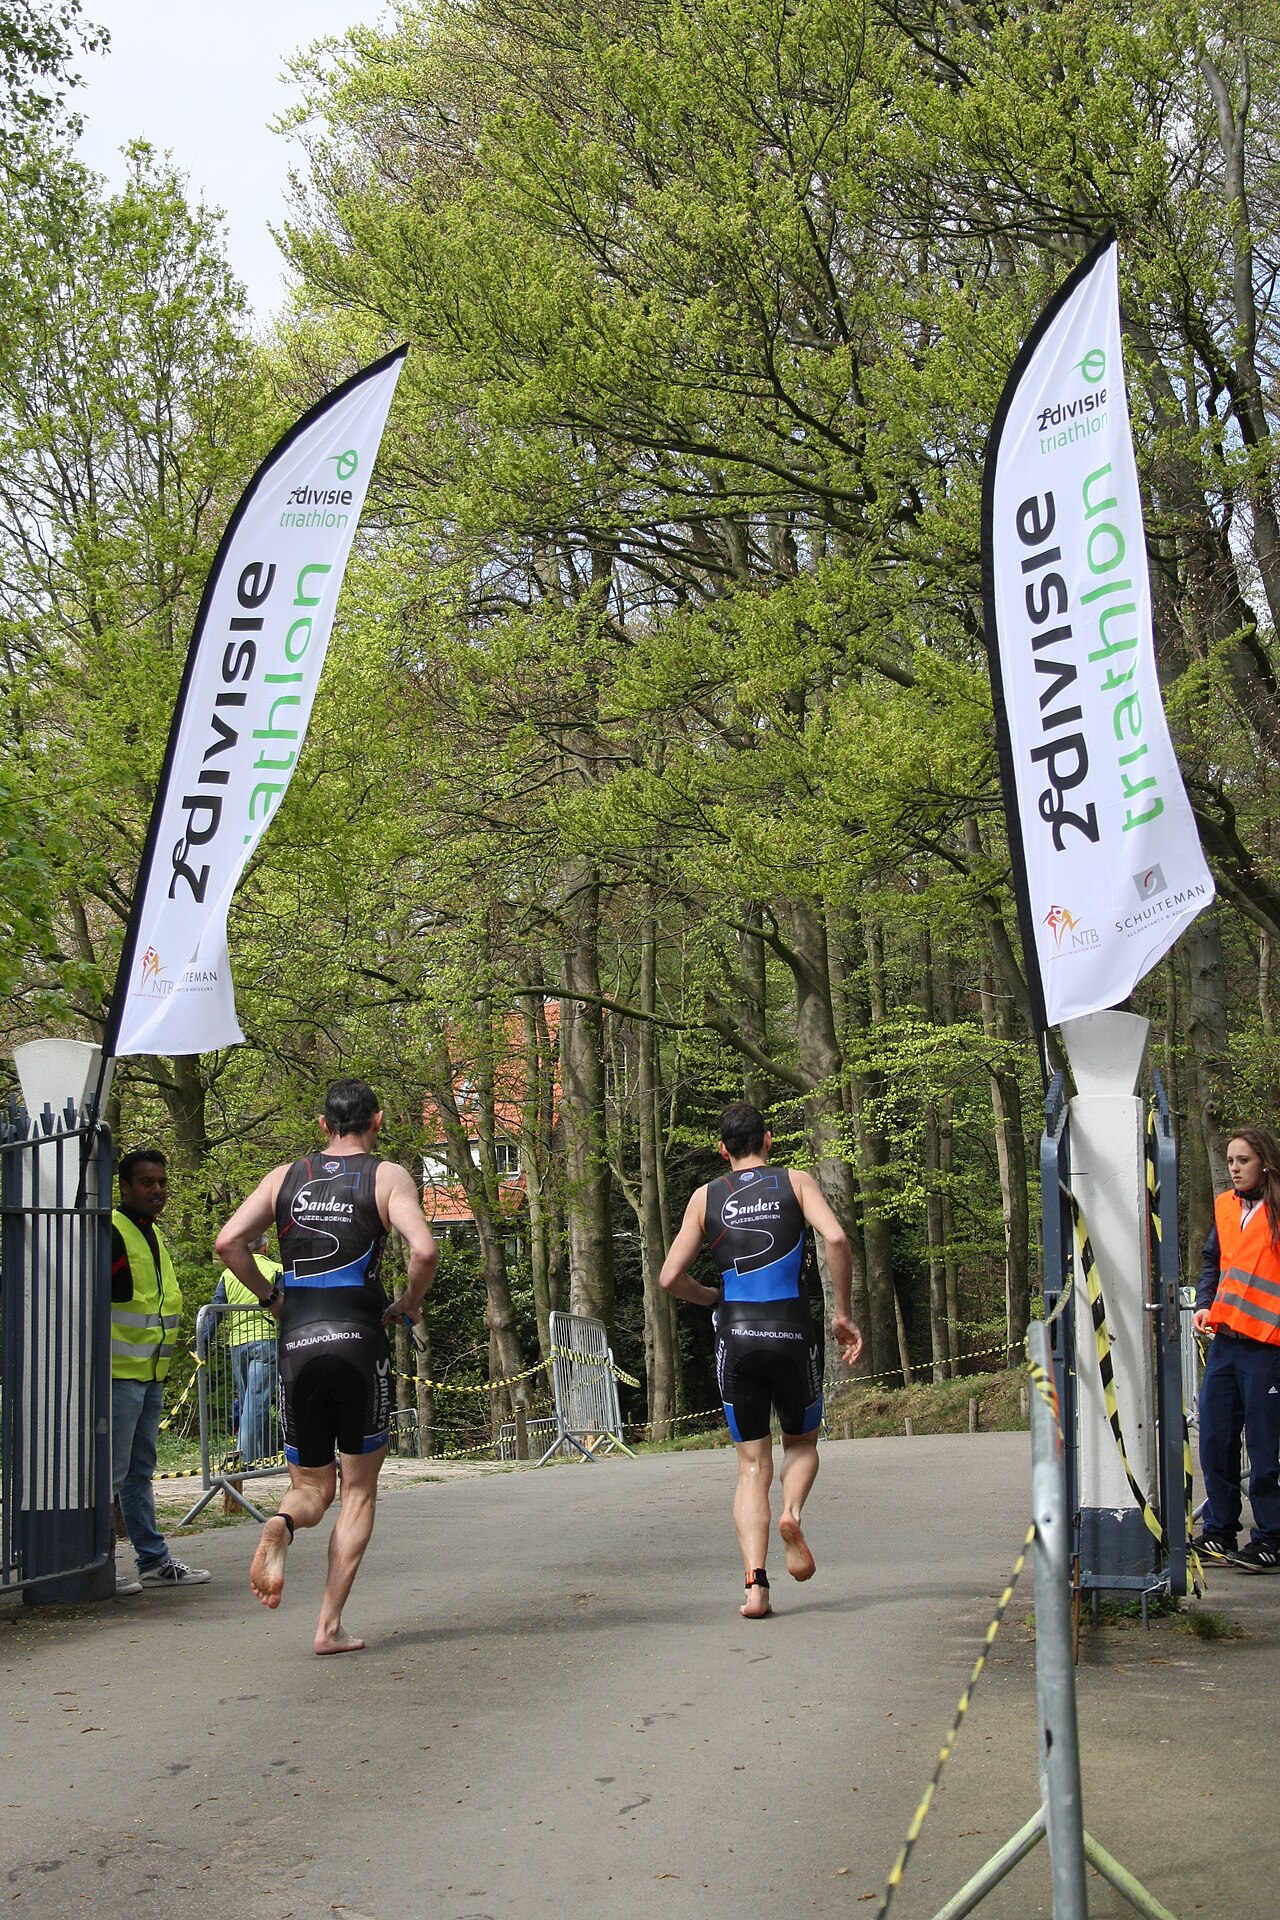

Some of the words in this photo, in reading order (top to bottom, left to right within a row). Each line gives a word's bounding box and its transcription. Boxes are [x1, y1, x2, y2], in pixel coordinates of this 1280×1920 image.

[1040, 412, 1108, 455] triathlon
[280, 509, 349, 528] triathlon
[1080, 462, 1164, 833] triathlon
[1115, 884, 1206, 932] SCHUITEMAN
[1072, 928, 1099, 949] NTB
[152, 980, 174, 995] NTB
[294, 1191, 354, 1214] Sanders
[725, 1198, 780, 1219] Sanders
[298, 1215, 352, 1223] PUZZELBOEKEN
[730, 1214, 781, 1225] PUZZELBOEKEN
[285, 1332, 362, 1351] TRI.AQUAPOLDRO.NL
[731, 1328, 803, 1340] TRI.AQUAPOLDRO.NL
[375, 1358, 391, 1428] Sanders
